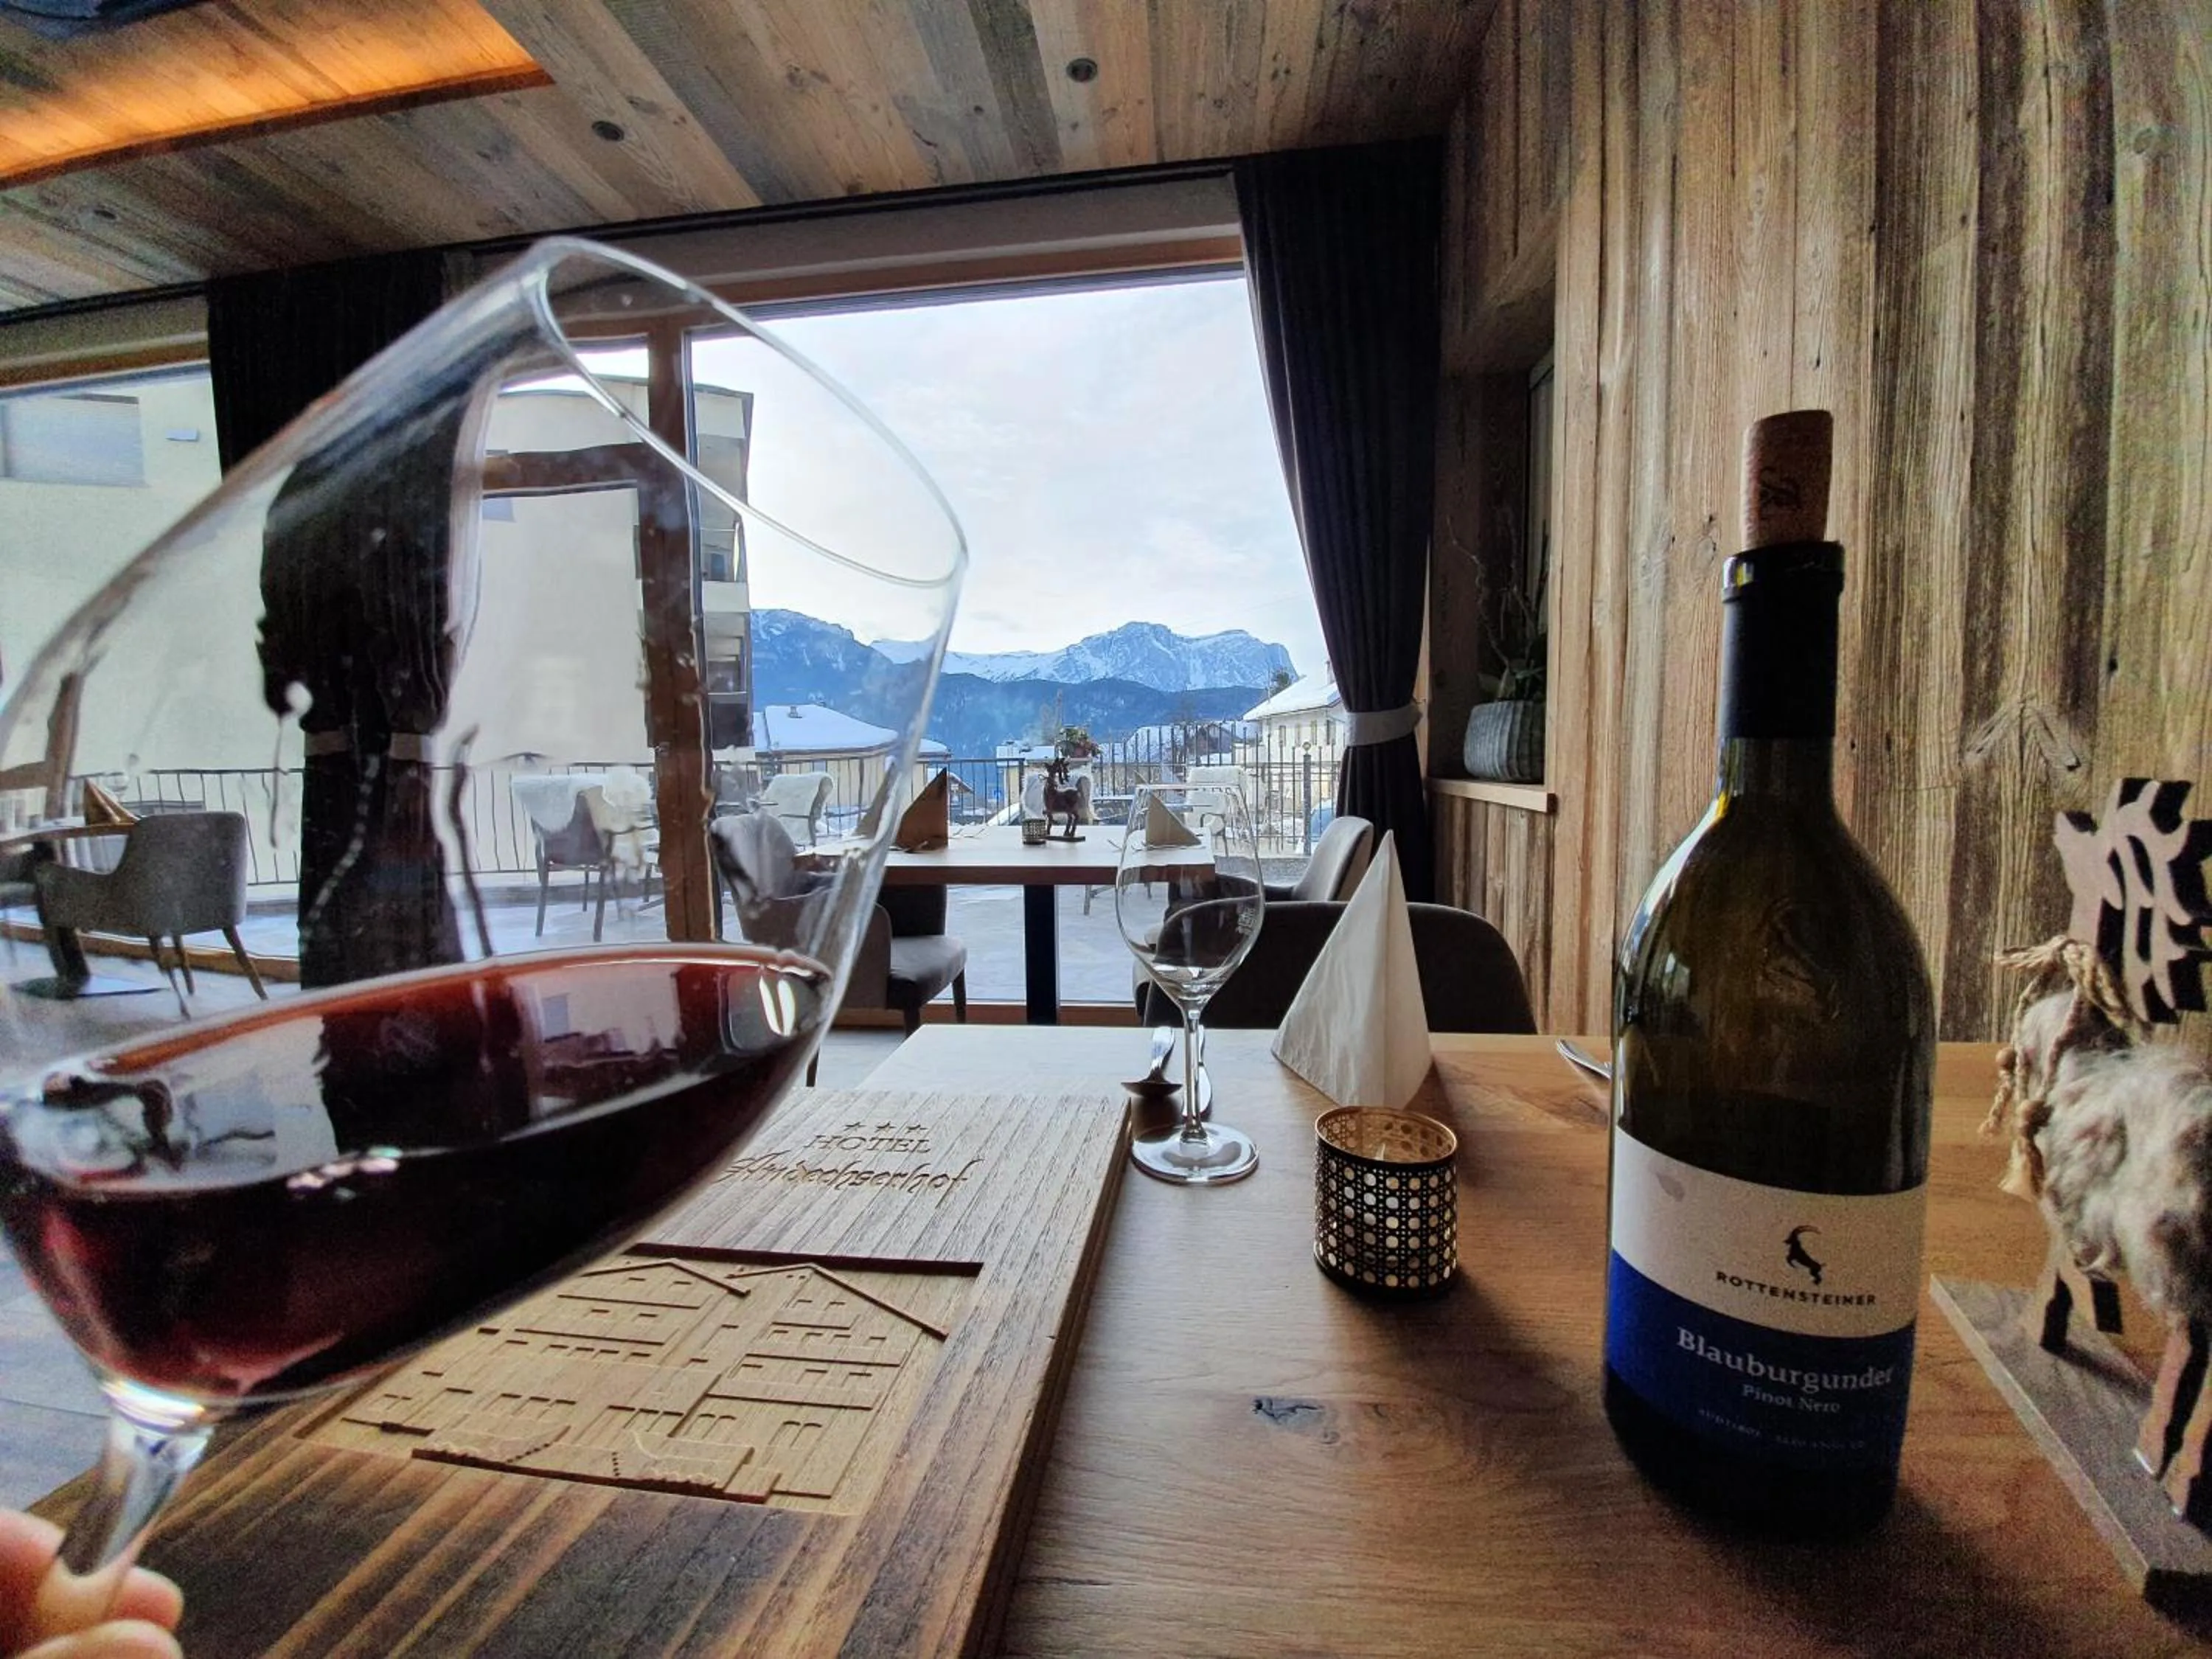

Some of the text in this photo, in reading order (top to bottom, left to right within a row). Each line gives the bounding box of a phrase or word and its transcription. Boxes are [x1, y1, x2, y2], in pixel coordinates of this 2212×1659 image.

[804, 1134, 931, 1154] HOTEL
[1716, 1270, 1877, 1307] ROTTENSTEINER
[1676, 1325, 1893, 1394] Blauburgunder
[1742, 1384, 1841, 1414] Pinot Nero
